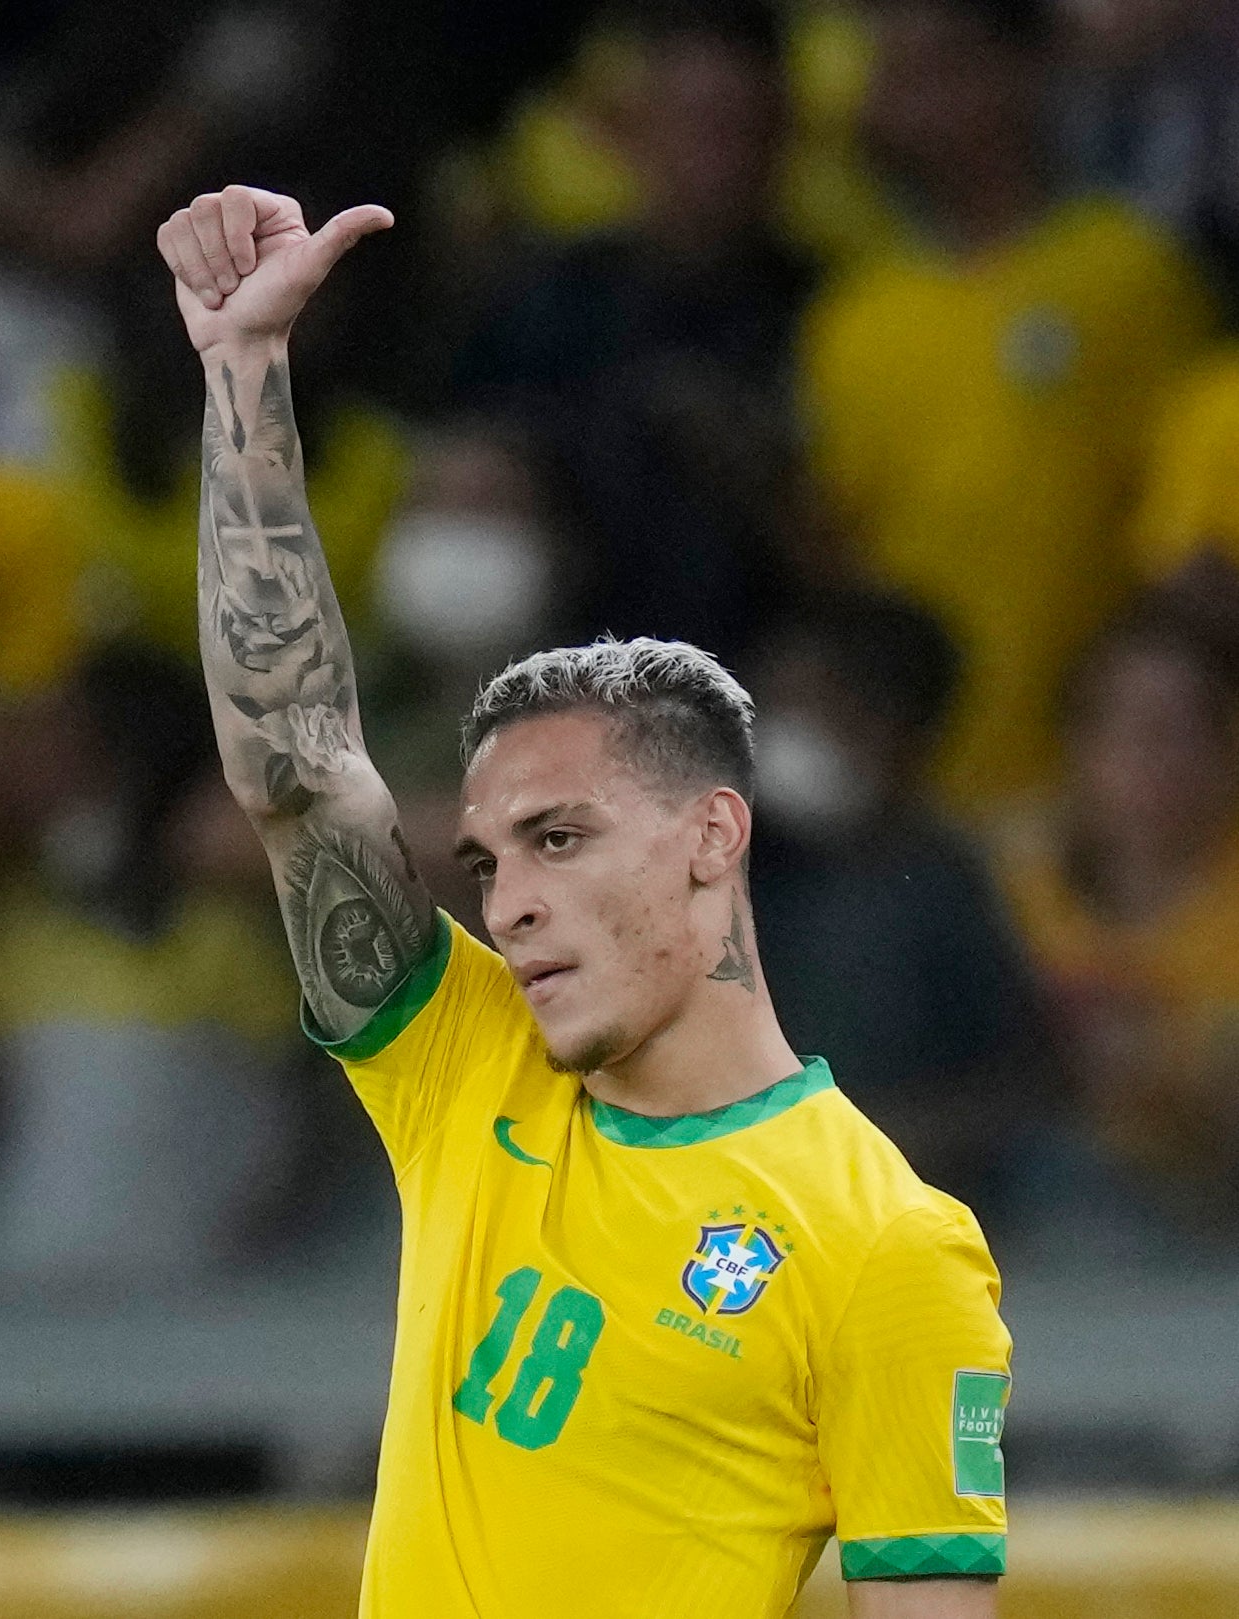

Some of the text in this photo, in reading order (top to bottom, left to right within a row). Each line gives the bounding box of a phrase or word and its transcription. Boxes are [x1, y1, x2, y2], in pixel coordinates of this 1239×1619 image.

[715, 1257, 749, 1277] CBF
[452, 1265, 605, 1451] 18
[655, 1307, 743, 1359] BRASIL
